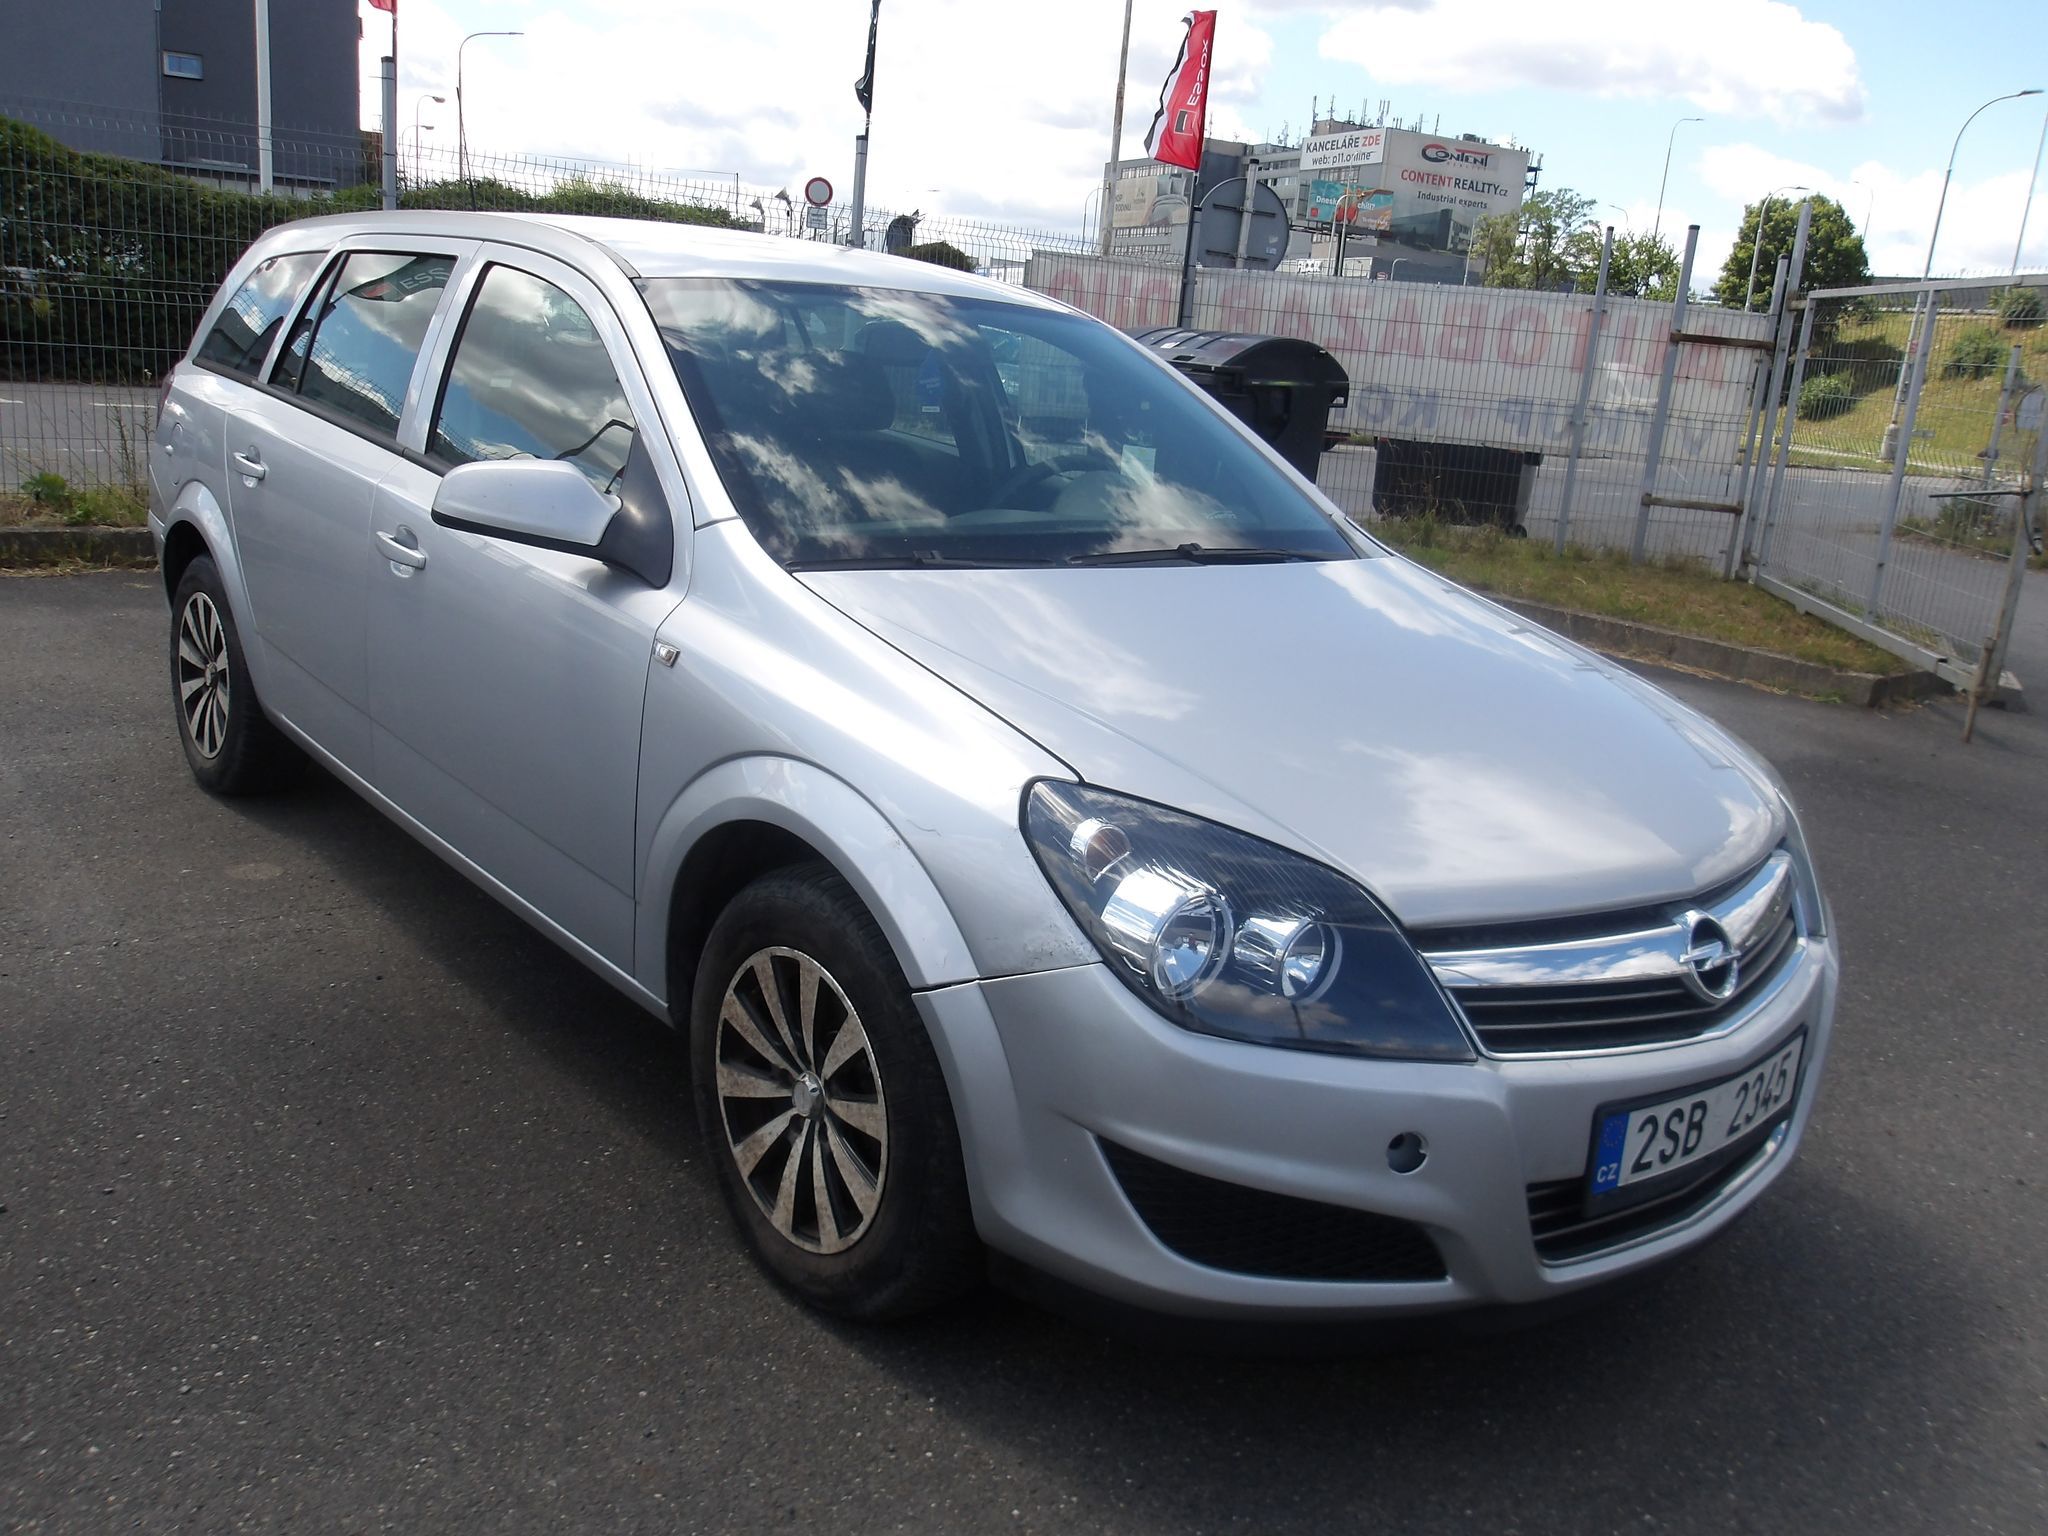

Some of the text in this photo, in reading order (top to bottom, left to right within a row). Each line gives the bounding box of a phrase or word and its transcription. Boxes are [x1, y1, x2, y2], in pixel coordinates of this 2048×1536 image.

[1306, 134, 1381, 153] KANCELÁŘE ZDE
[1312, 154, 1330, 165] web:
[1417, 190, 1488, 209] Industrial experts
[1631, 1051, 1792, 1174] 2SB 2345
[1597, 1163, 1618, 1183] CZ
